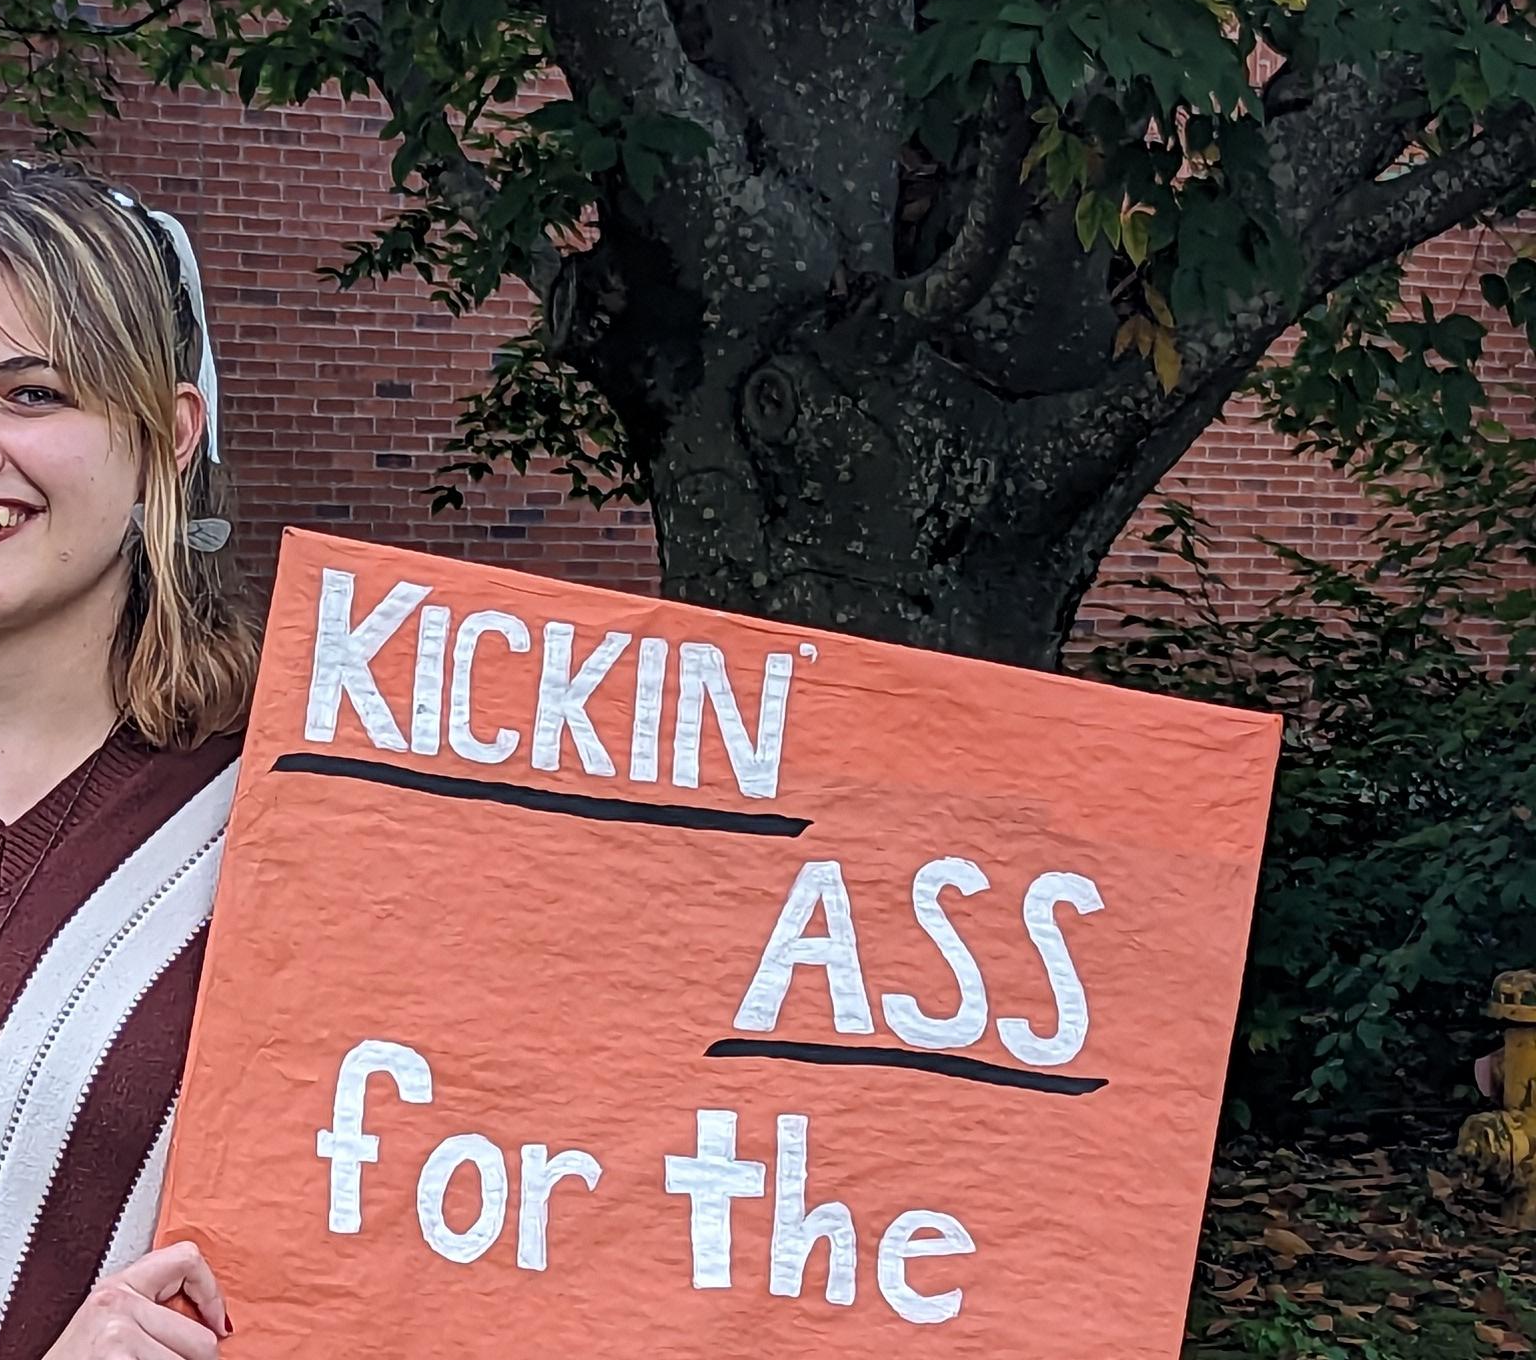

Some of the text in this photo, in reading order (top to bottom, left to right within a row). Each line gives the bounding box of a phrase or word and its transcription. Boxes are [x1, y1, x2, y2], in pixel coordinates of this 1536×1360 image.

[303, 567, 818, 800] KICKIN'
[732, 855, 1105, 1067] ASS
[316, 1038, 977, 1325] for the
